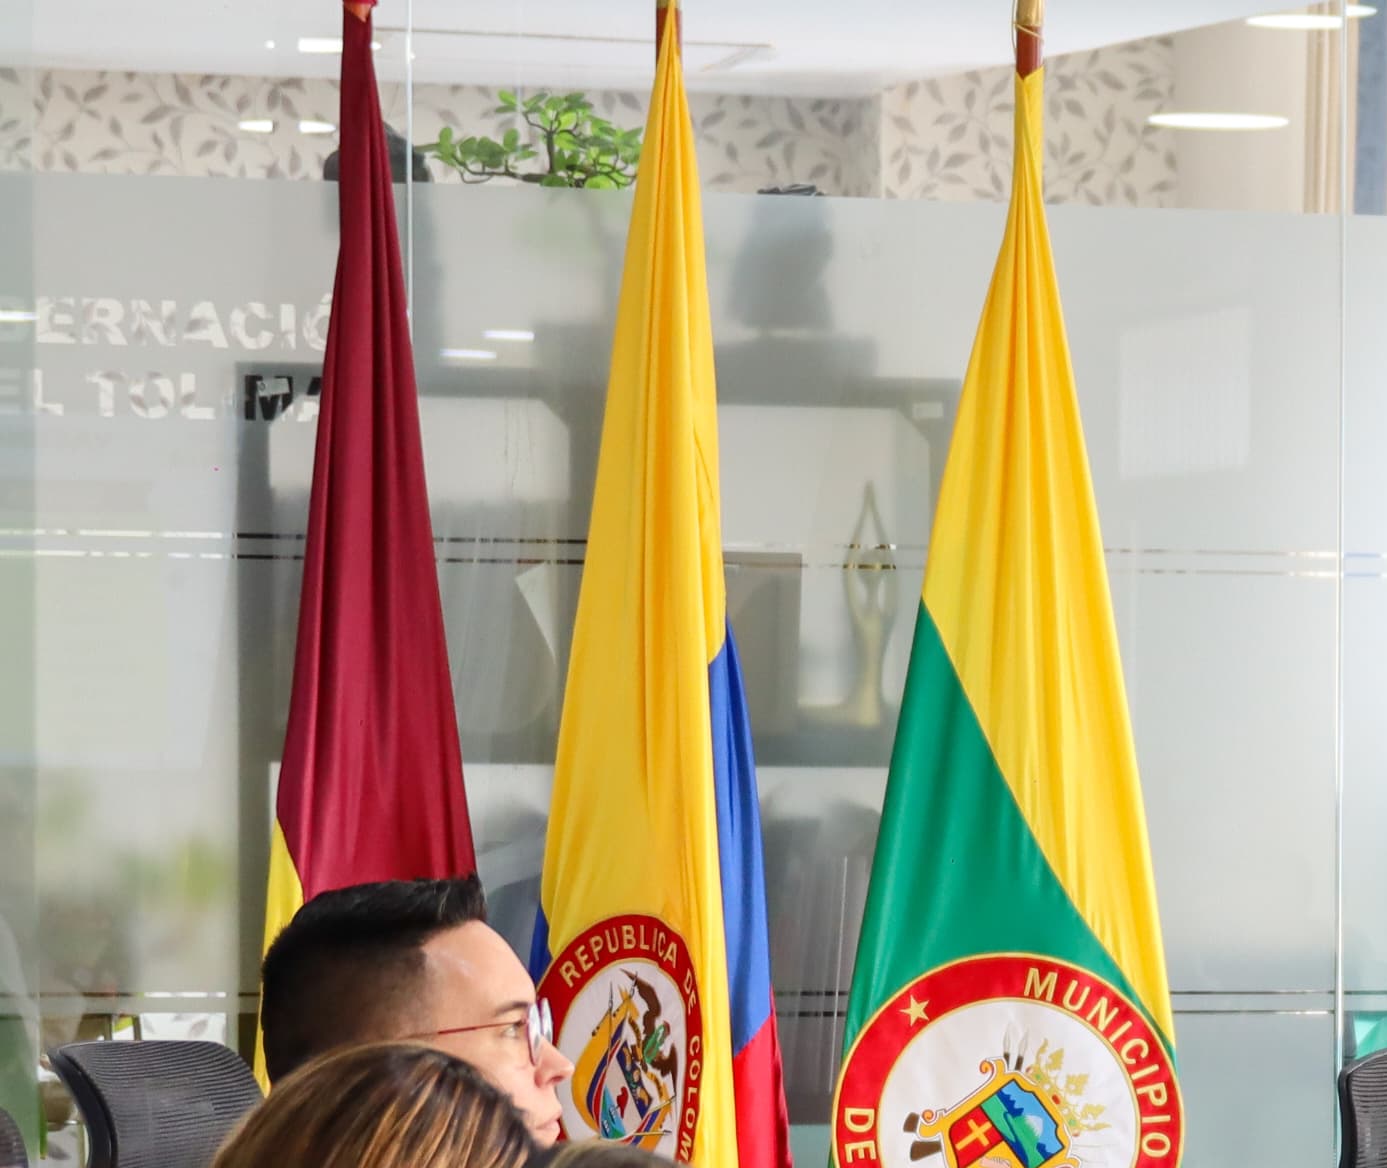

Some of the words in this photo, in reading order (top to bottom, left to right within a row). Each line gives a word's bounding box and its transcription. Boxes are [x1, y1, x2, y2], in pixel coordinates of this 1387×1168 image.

[559, 924, 678, 988] REPUBLICA
[684, 968, 698, 1015] DE
[1023, 967, 1172, 1158] MUNICIPIO
[679, 1035, 700, 1162] COLOM
[844, 1107, 876, 1163] DE
